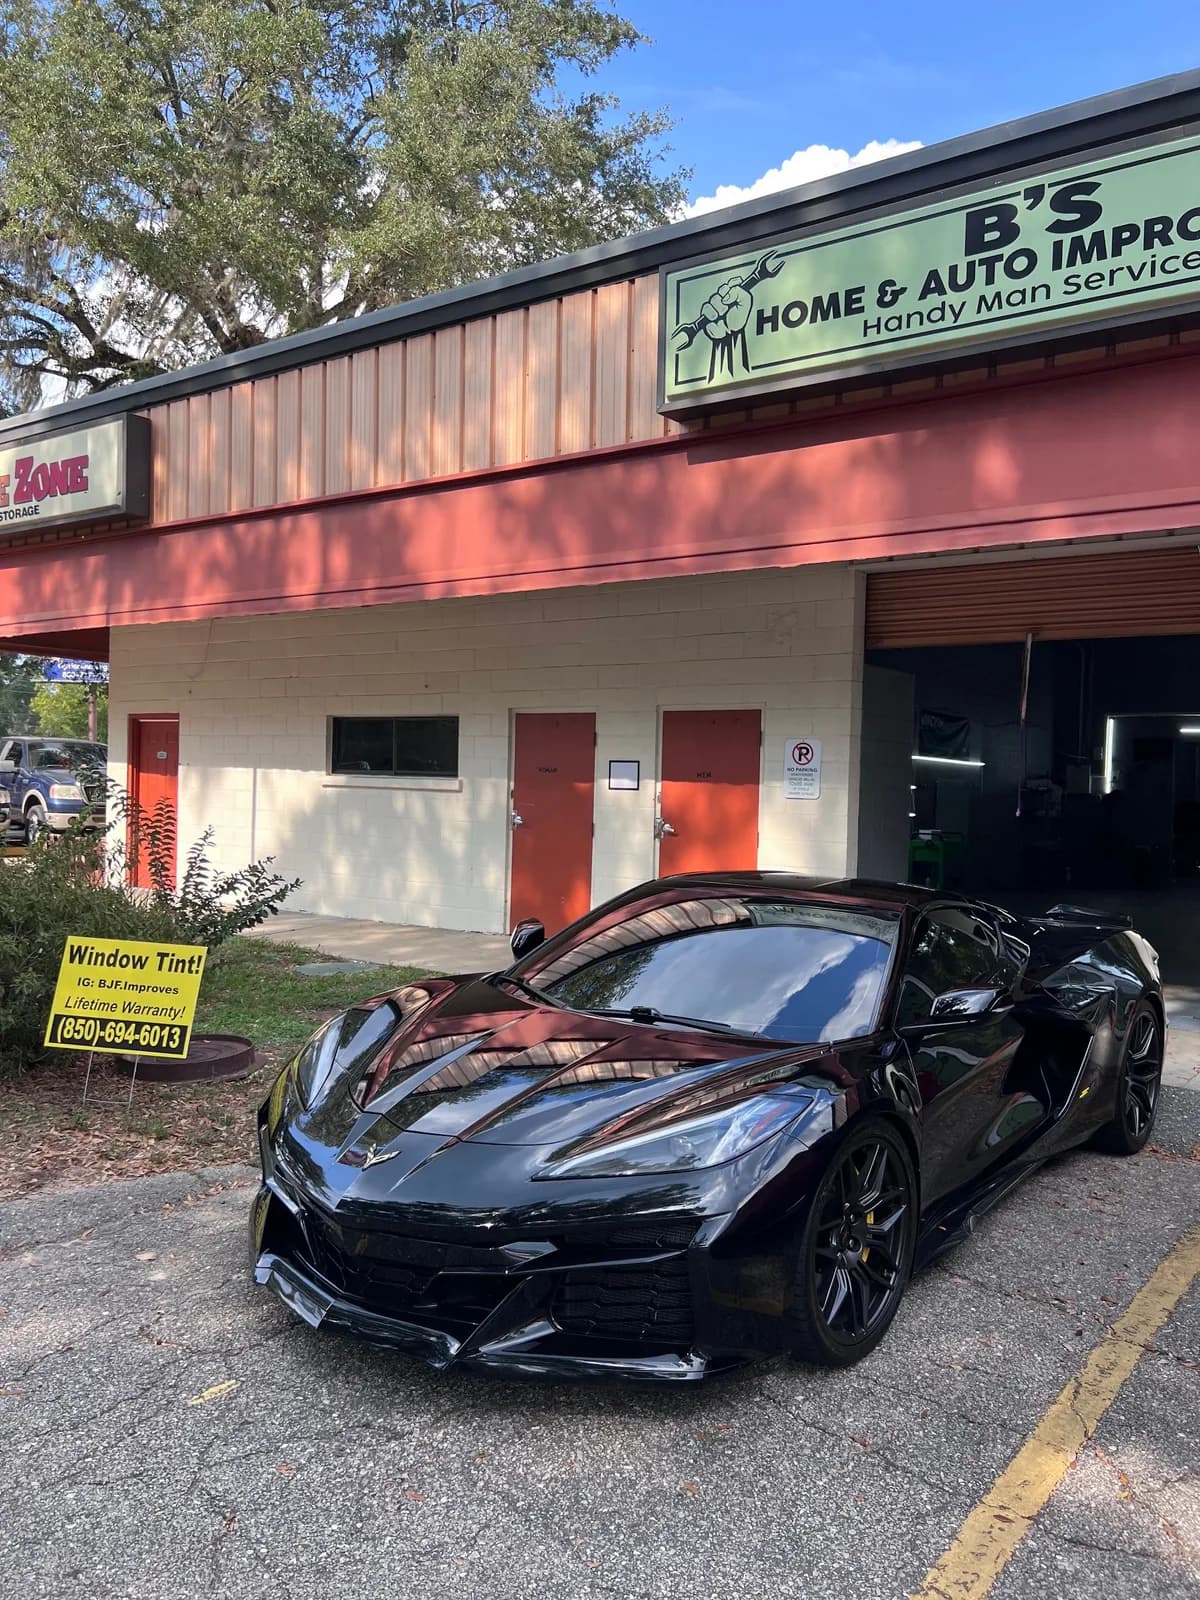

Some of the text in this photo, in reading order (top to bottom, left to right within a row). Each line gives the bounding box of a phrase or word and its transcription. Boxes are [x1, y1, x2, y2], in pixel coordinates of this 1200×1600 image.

[964, 181, 1103, 257] B'S
[756, 206, 1200, 336] HOME & AUTO IMPRO
[863, 251, 1200, 337] Handy Man Service
[13, 455, 89, 505] ZONE
[68, 944, 203, 975] Window Tint!
[77, 977, 179, 995] IG: BJF.Improves
[64, 996, 186, 1021] Lifetime Warranty!
[57, 1016, 181, 1049] (850)-694-6013
